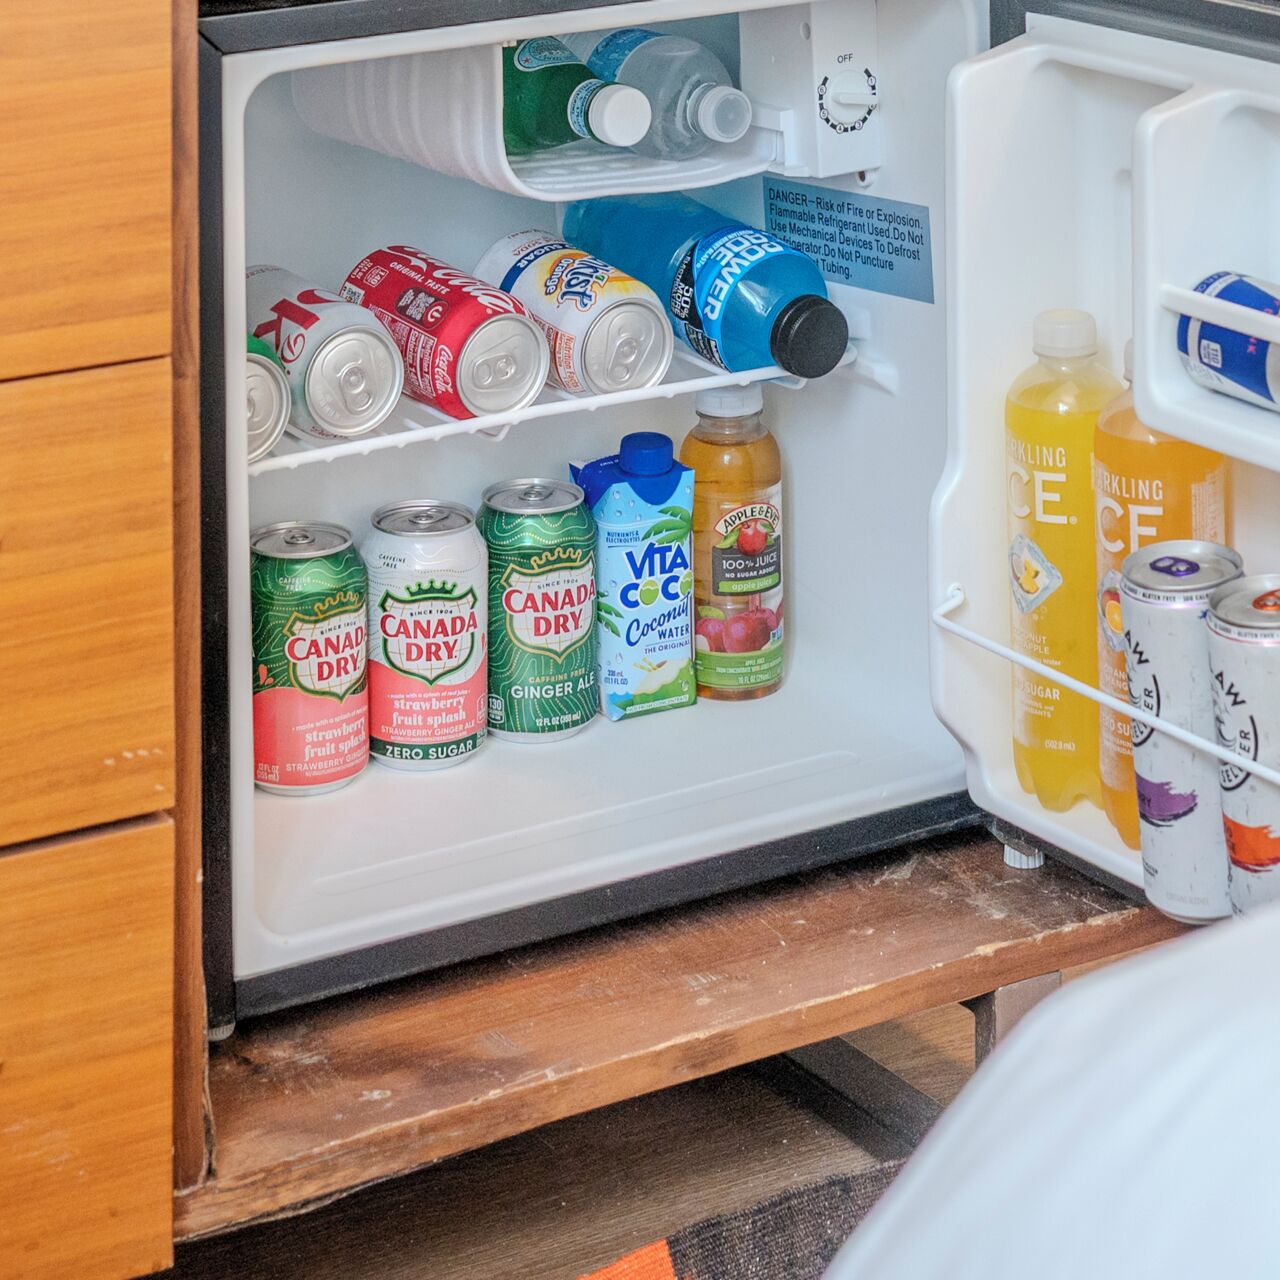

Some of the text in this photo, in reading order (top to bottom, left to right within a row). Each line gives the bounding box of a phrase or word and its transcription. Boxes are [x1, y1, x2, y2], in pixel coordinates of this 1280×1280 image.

[837, 53, 853, 64] OFF
[770, 203, 815, 224] Flammable
[817, 214, 866, 234] Refrigerant
[907, 232, 924, 246] Not
[836, 201, 846, 214] of
[847, 203, 863, 218] Fire
[865, 210, 875, 220] or
[876, 208, 923, 230] Explosion.
[770, 218, 920, 261] Use Mechanical Devices To Defrost
[516, 243, 563, 268] SUGAR
[837, 247, 854, 261] Not
[855, 251, 894, 270] Puncture
[370, 271, 384, 285] 140
[389, 261, 451, 295] ORIGINAL TASTE
[822, 259, 853, 279] Tubing.
[703, 241, 784, 321] POWER
[672, 282, 686, 315] MORE
[679, 285, 693, 319] 50%
[1007, 463, 1068, 524] CE
[722, 505, 780, 534] APPLE & EVE
[378, 553, 406, 563] CAFFEINE
[382, 561, 397, 569] FREE
[625, 543, 690, 580] VITA
[755, 552, 777, 568] JUICE
[537, 580, 560, 589] SINCE
[731, 579, 772, 592] apple juice
[737, 570, 758, 578] SUGAR
[504, 578, 596, 614] CANADA
[620, 570, 693, 609] COCO
[320, 624, 342, 634] SINCE
[379, 610, 478, 639] CANADA
[533, 608, 583, 637] DRY
[626, 592, 691, 647] Coconut
[658, 623, 690, 641] WATER
[405, 639, 458, 662] DRY
[644, 647, 656, 655] THE
[317, 650, 360, 682] DRY
[511, 672, 595, 699] GINGER ALE
[529, 674, 568, 683] CAFFEINE
[393, 695, 465, 710] strawberry
[488, 698, 501, 710] 130
[381, 720, 475, 737] STRAWBERRY GINGER ALE
[392, 712, 425, 726] fruit
[427, 706, 467, 728] splash
[536, 717, 543, 727] 12
[551, 716, 560, 725] OZ
[305, 717, 365, 742] strawberry
[304, 741, 336, 761] fruit
[338, 730, 366, 755] splash
[385, 739, 473, 759] ZERO SUGAR
[286, 755, 344, 772] STRAWBERRY
